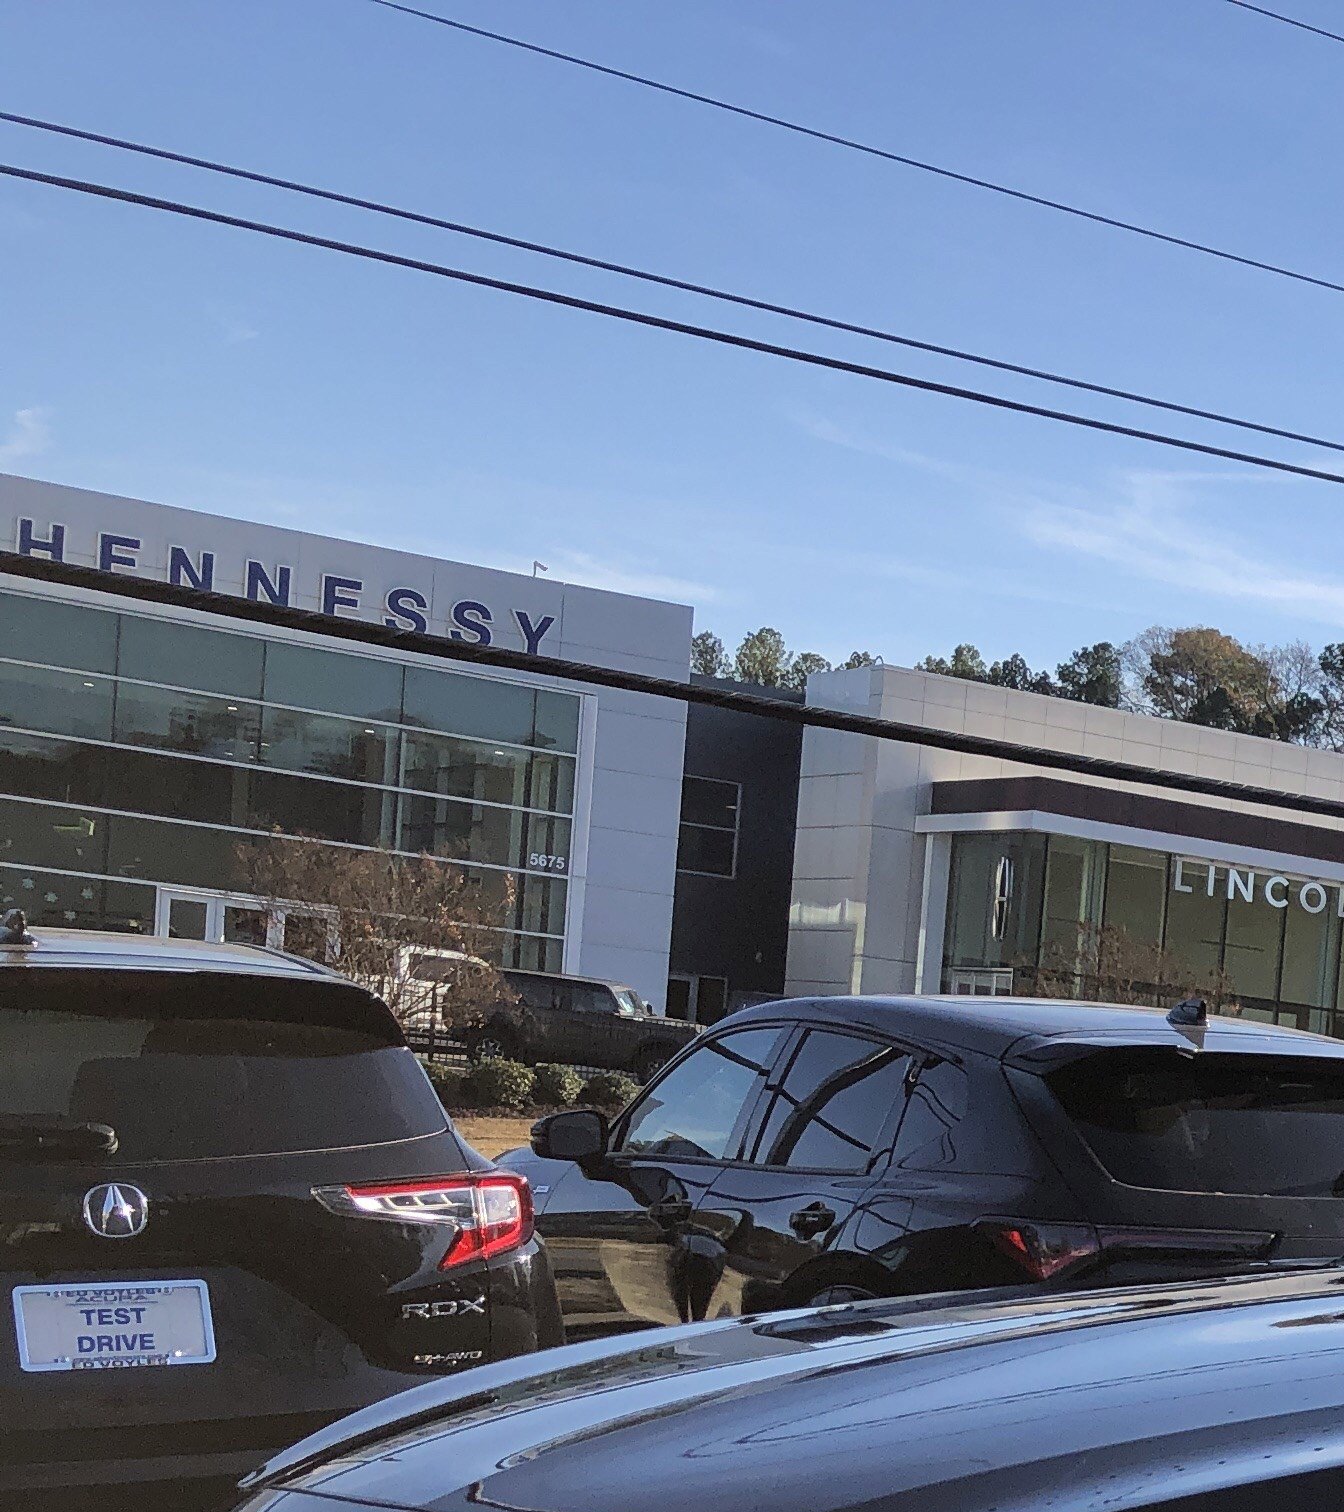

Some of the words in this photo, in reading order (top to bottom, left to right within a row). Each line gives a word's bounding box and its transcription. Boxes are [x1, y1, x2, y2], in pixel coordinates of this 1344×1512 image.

[16, 516, 557, 656] HENNESSY
[529, 852, 565, 870] 5675
[80, 1307, 146, 1326] TEST
[401, 1295, 486, 1319] RDX
[77, 1332, 156, 1353] DRIVE
